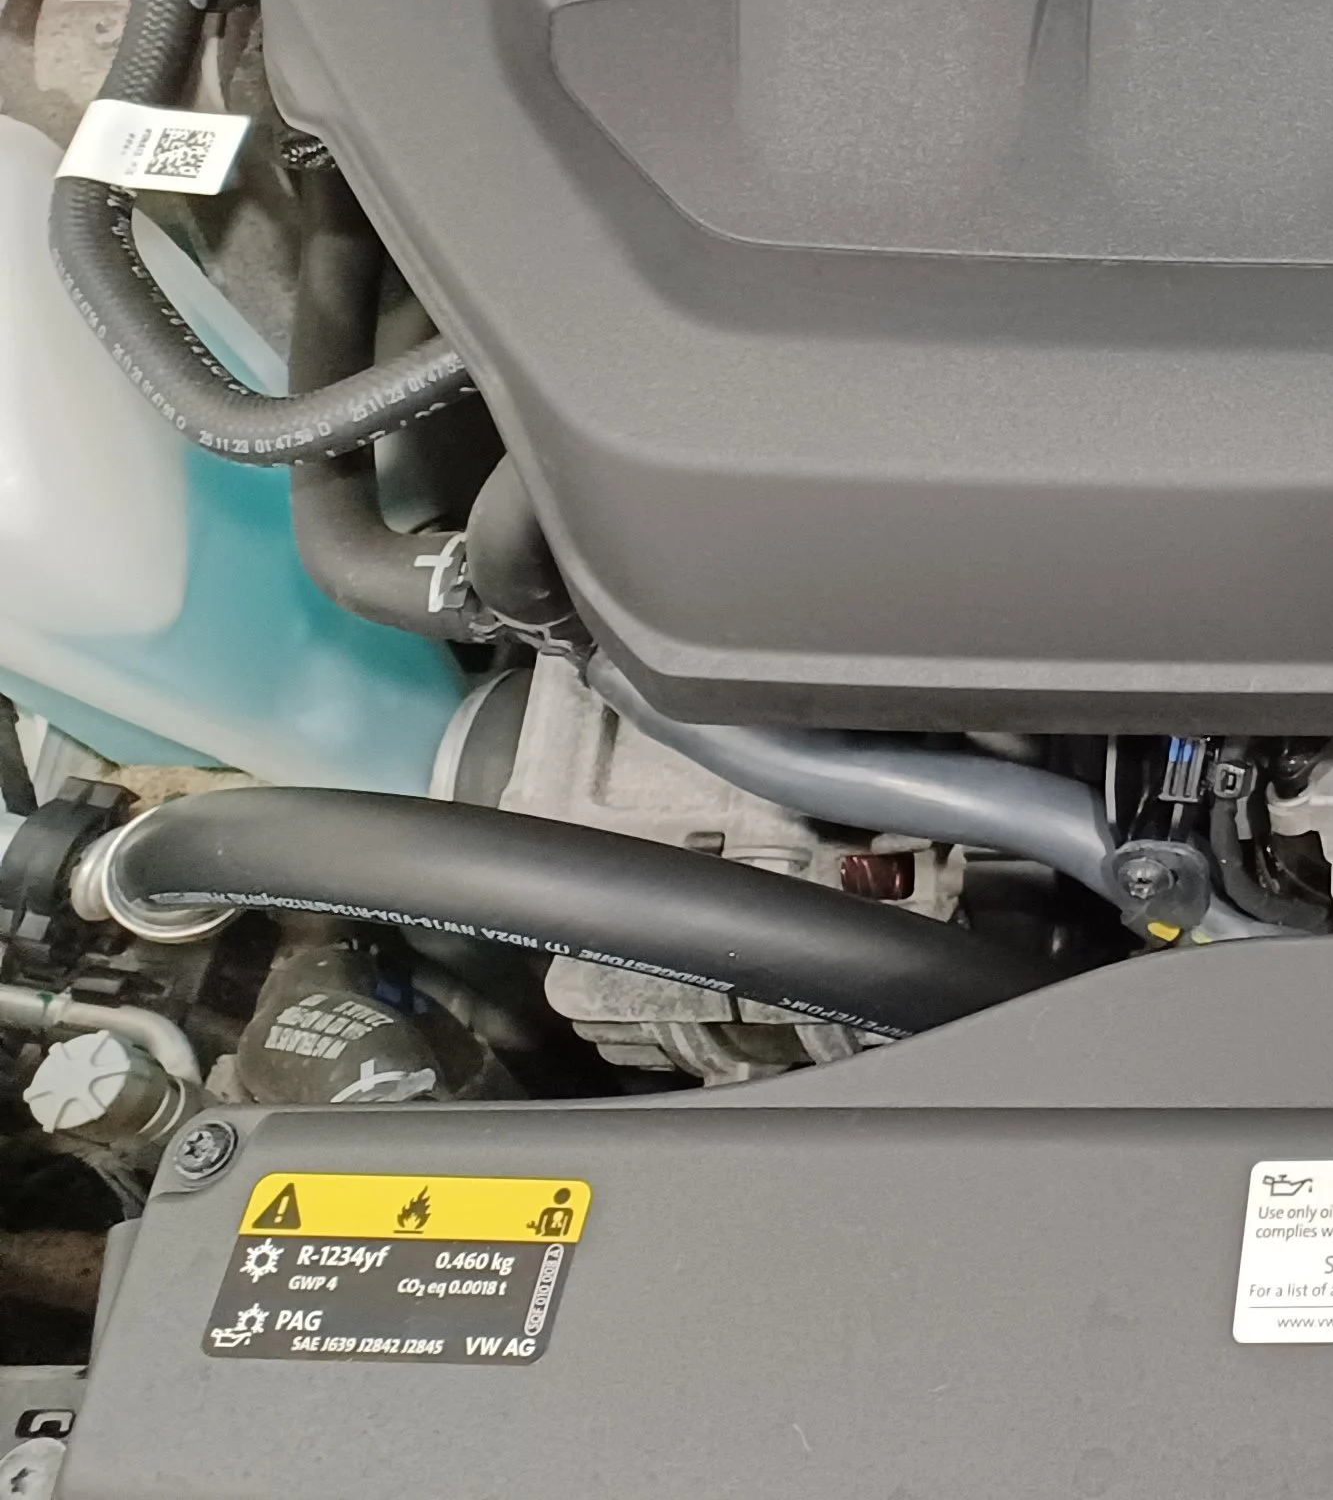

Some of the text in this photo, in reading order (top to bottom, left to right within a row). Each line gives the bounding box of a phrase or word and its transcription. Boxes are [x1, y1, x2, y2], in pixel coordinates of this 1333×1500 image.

[1258, 1205, 1284, 1220] Use
[1287, 1205, 1317, 1223] only
[1255, 1224, 1317, 1242] complies
[296, 1245, 516, 1276] R-1234yf 0.460 kg
[288, 1275, 326, 1291] GWP
[326, 1275, 339, 1291] 4
[426, 1281, 448, 1298] eq
[448, 1279, 498, 1296] 0.0018
[498, 1281, 508, 1296] t
[1249, 1283, 1270, 1297] For
[1275, 1286, 1283, 1297] a
[1287, 1283, 1307, 1297] list
[1312, 1282, 1328, 1297] of
[274, 1309, 323, 1332] PAG
[291, 1336, 537, 1357] SAE J639 J2842 J2845 VW AG
